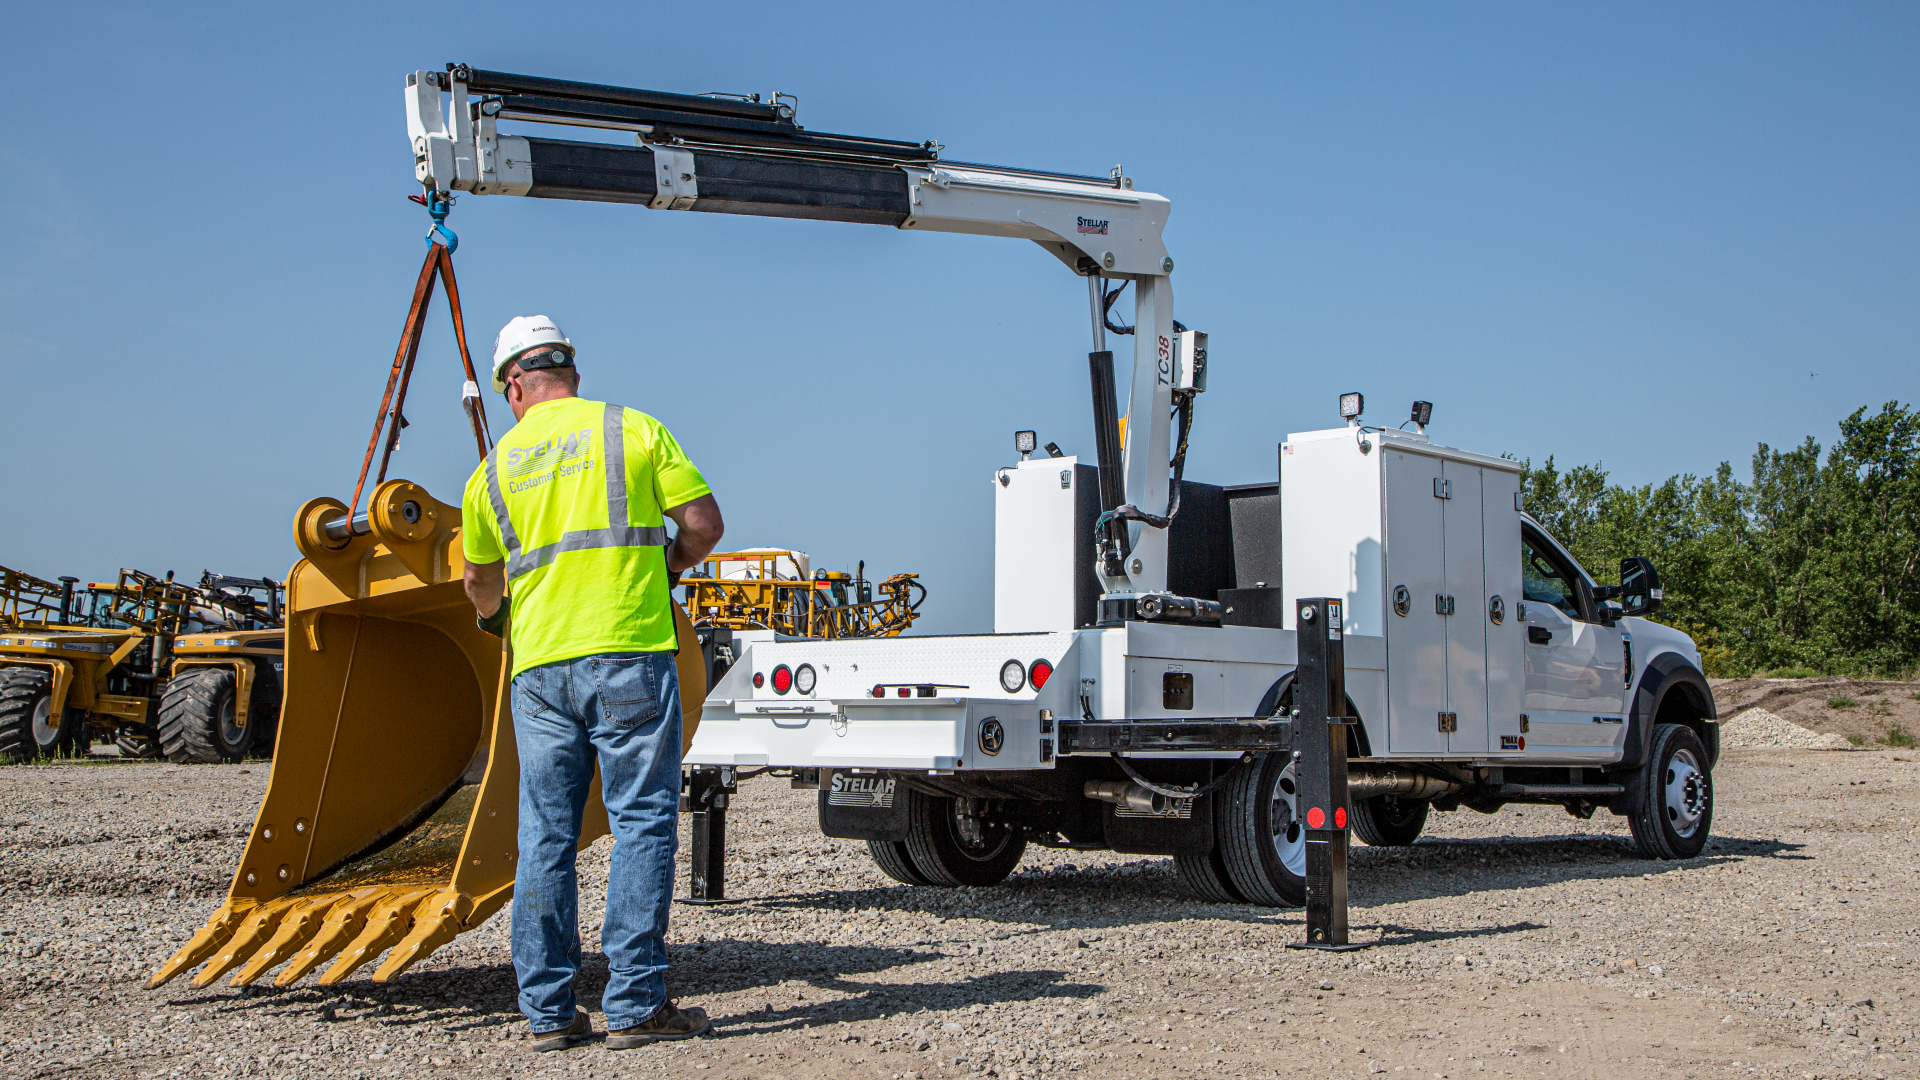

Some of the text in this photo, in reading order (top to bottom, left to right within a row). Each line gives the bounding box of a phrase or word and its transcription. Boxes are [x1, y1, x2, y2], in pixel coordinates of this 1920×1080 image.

[1077, 215, 1108, 228] STELLAR
[1158, 335, 1169, 386] TC38
[506, 428, 593, 466] STELLAR
[508, 458, 595, 494] Customer Service
[1500, 735, 1518, 750] TMAX
[831, 772, 896, 794] STELLAR
